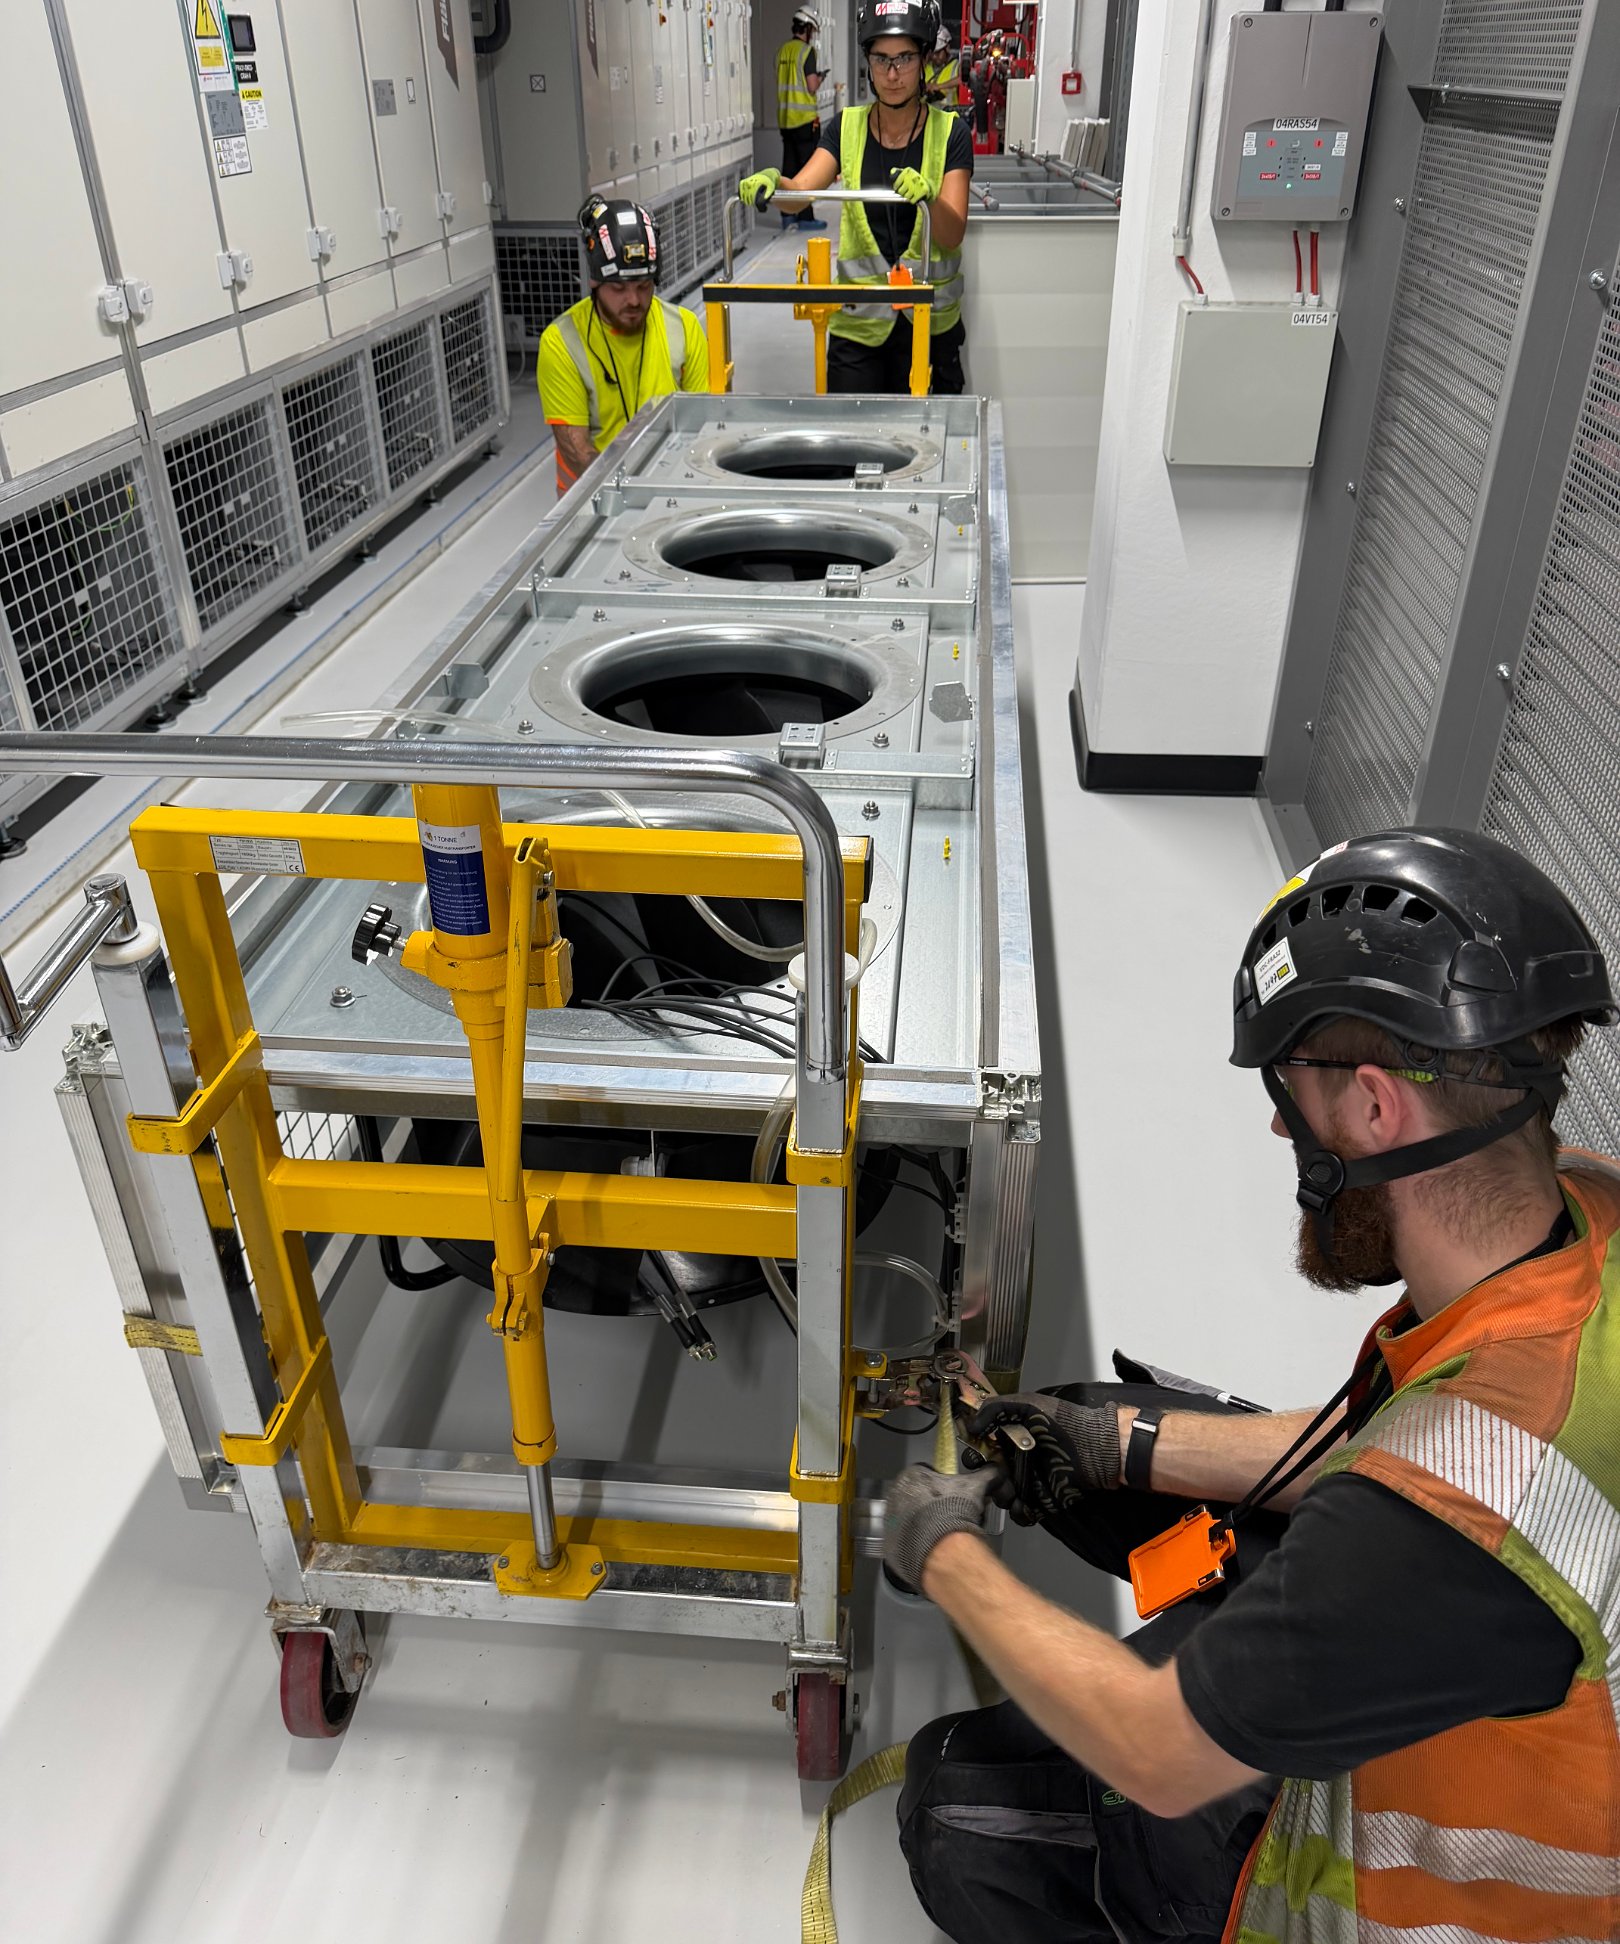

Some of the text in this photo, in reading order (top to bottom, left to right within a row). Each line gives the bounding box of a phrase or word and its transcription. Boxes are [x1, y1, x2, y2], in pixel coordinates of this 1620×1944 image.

[245, 90, 262, 98] CAUTION
[1276, 119, 1317, 129] 04RAS54
[1293, 314, 1328, 324] 04VT54
